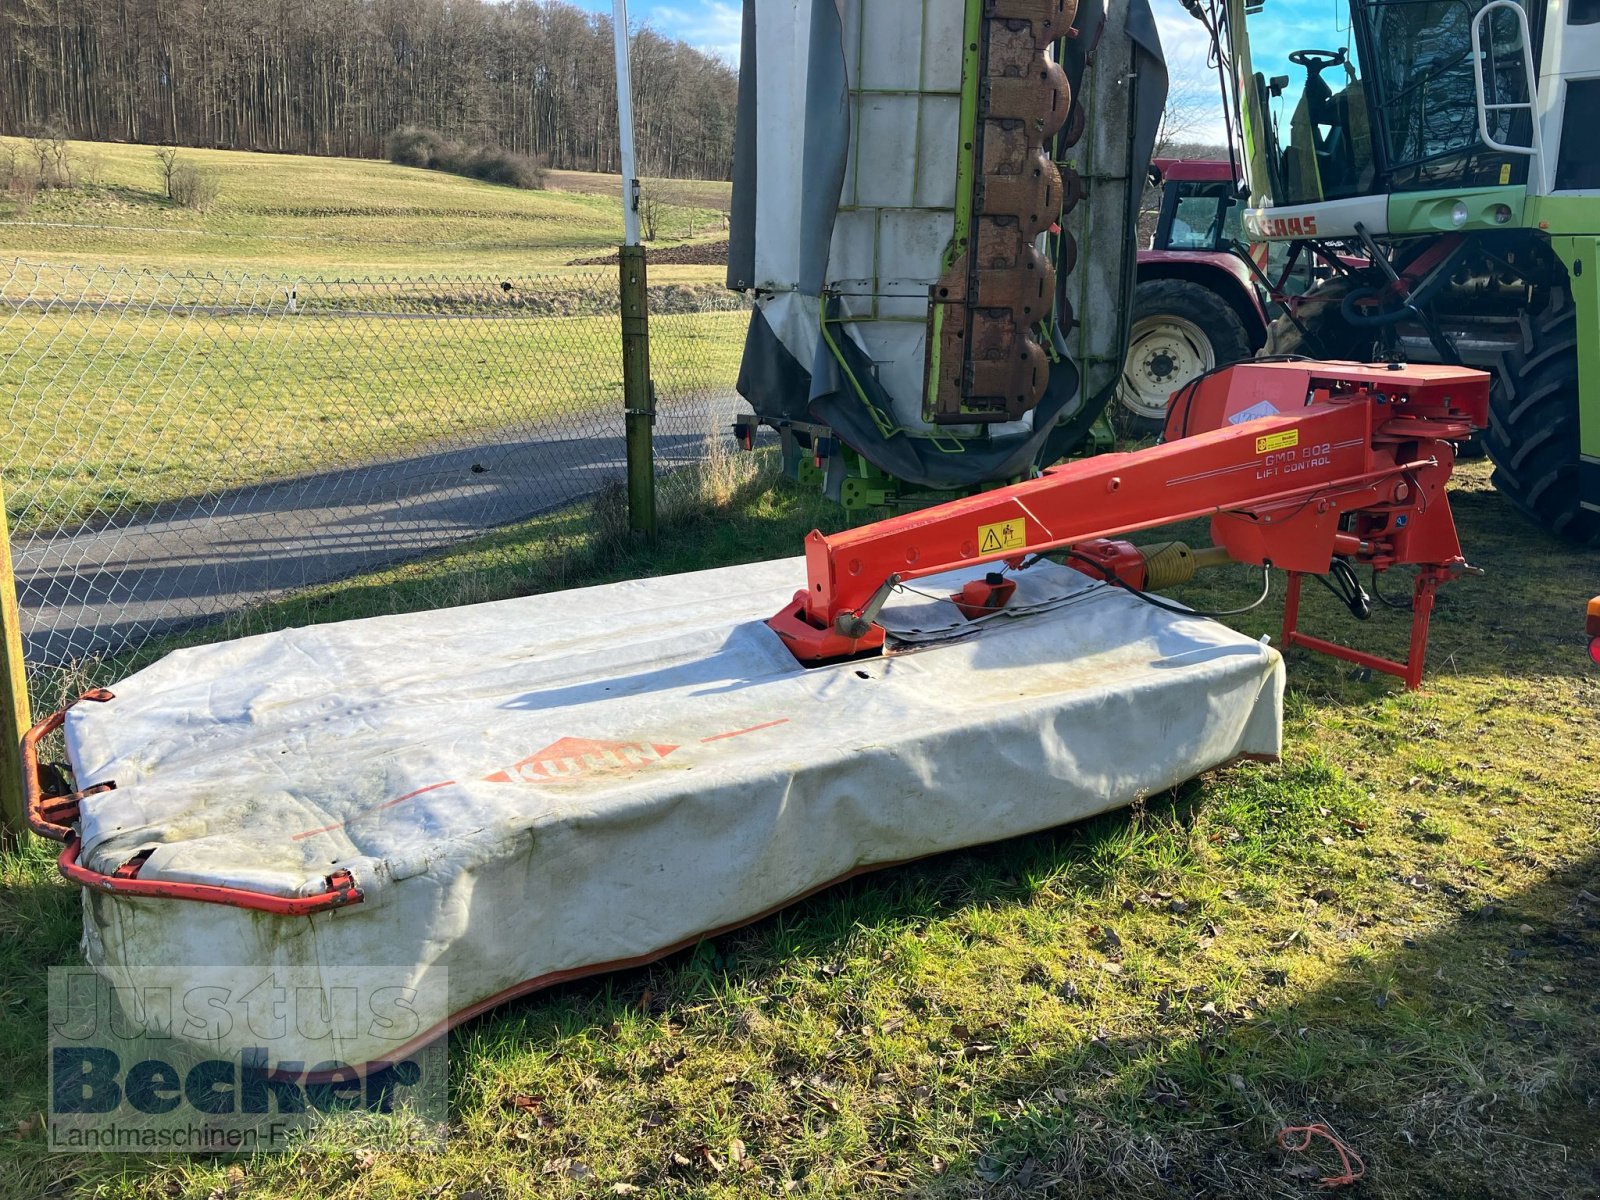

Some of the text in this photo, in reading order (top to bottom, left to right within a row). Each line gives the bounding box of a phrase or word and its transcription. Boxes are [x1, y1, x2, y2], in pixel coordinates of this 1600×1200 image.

[1260, 215, 1317, 237] CLAAS
[1265, 443, 1331, 466] GMD 802
[1256, 456, 1331, 480] LIFT CONTROL
[503, 742, 663, 783] KUHN
